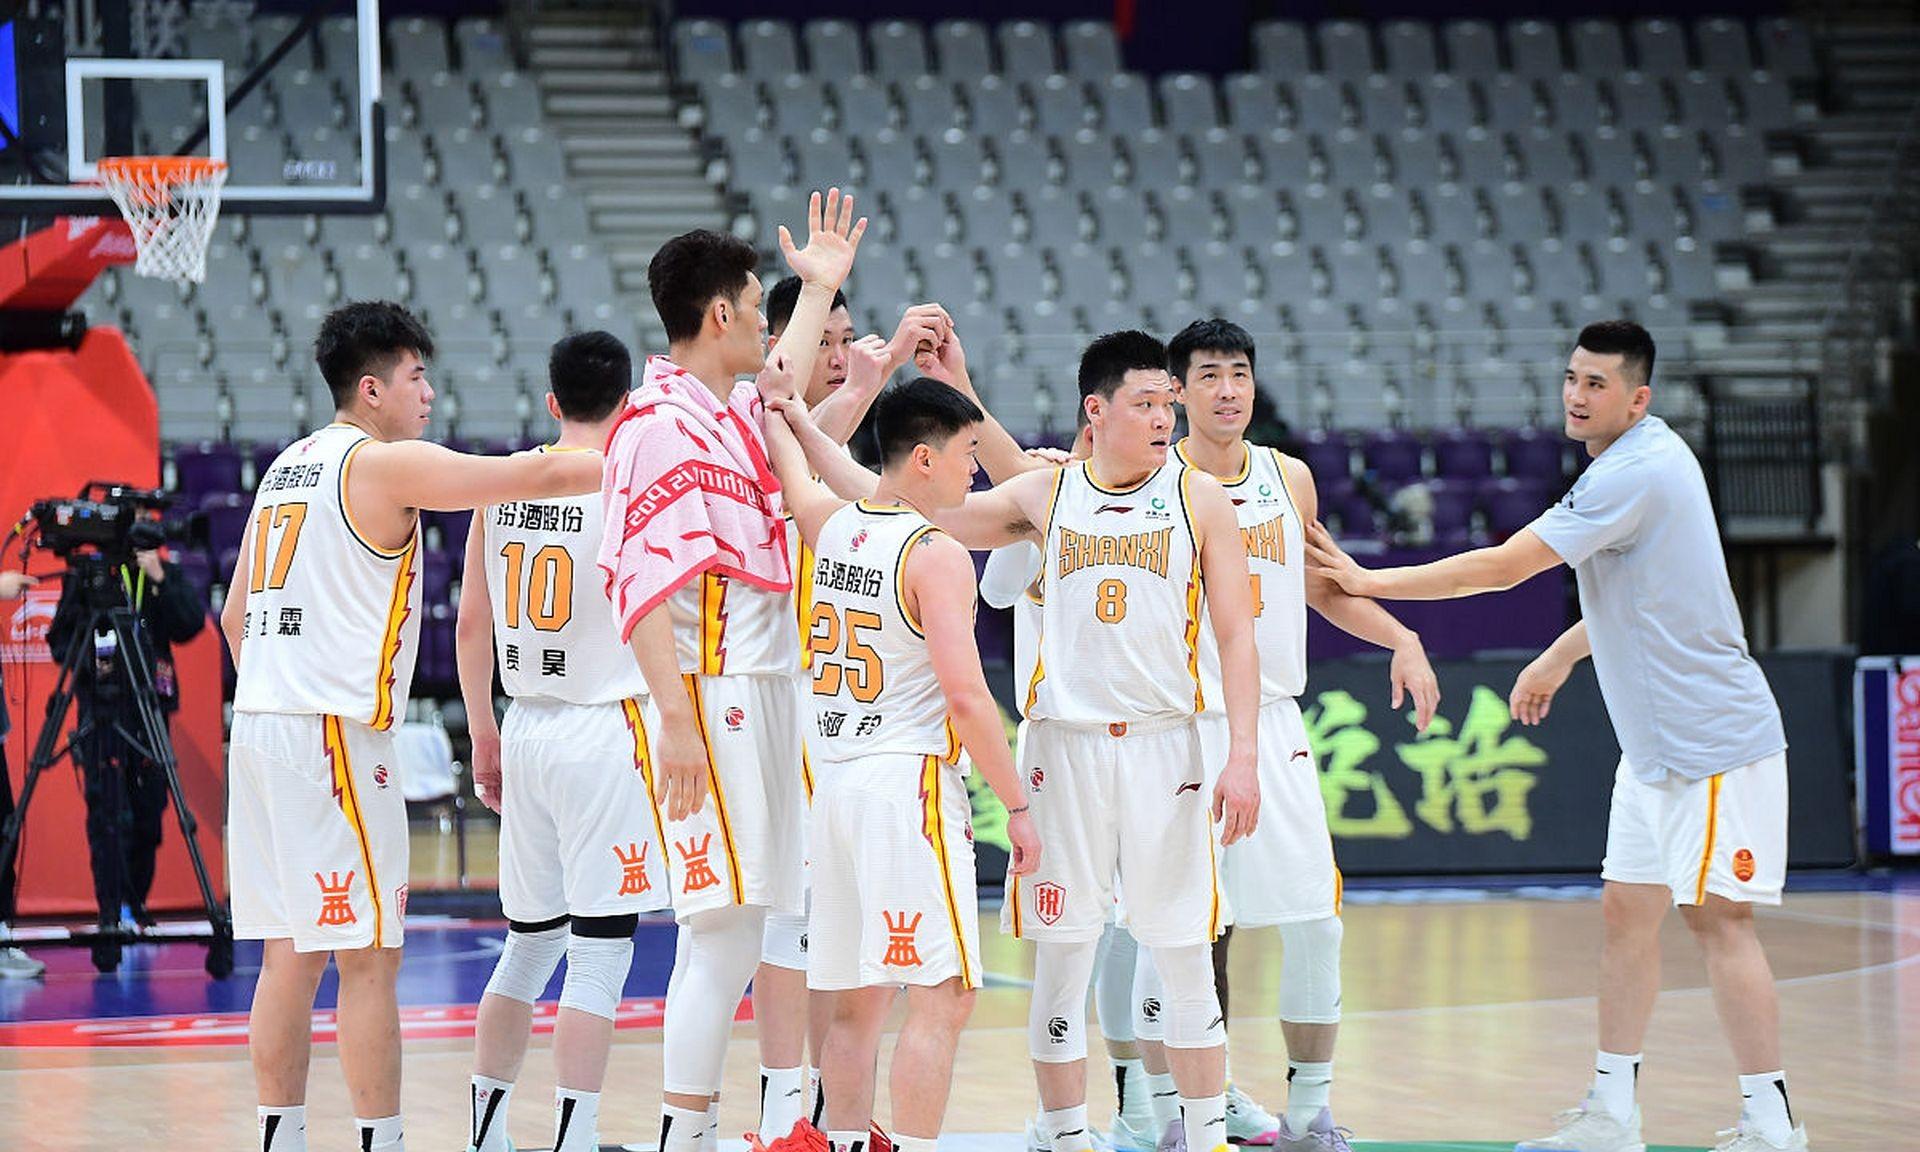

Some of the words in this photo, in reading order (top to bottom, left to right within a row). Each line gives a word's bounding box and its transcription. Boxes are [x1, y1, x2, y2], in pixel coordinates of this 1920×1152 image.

[497, 502, 584, 533] 汾酒股份
[1239, 513, 1286, 566] NXI
[250, 502, 308, 594] 17
[1059, 525, 1175, 580] SHANXI
[500, 541, 574, 632] 10
[815, 557, 884, 598] 汾酒股份
[1096, 578, 1127, 624] 8
[811, 601, 884, 703] 25
